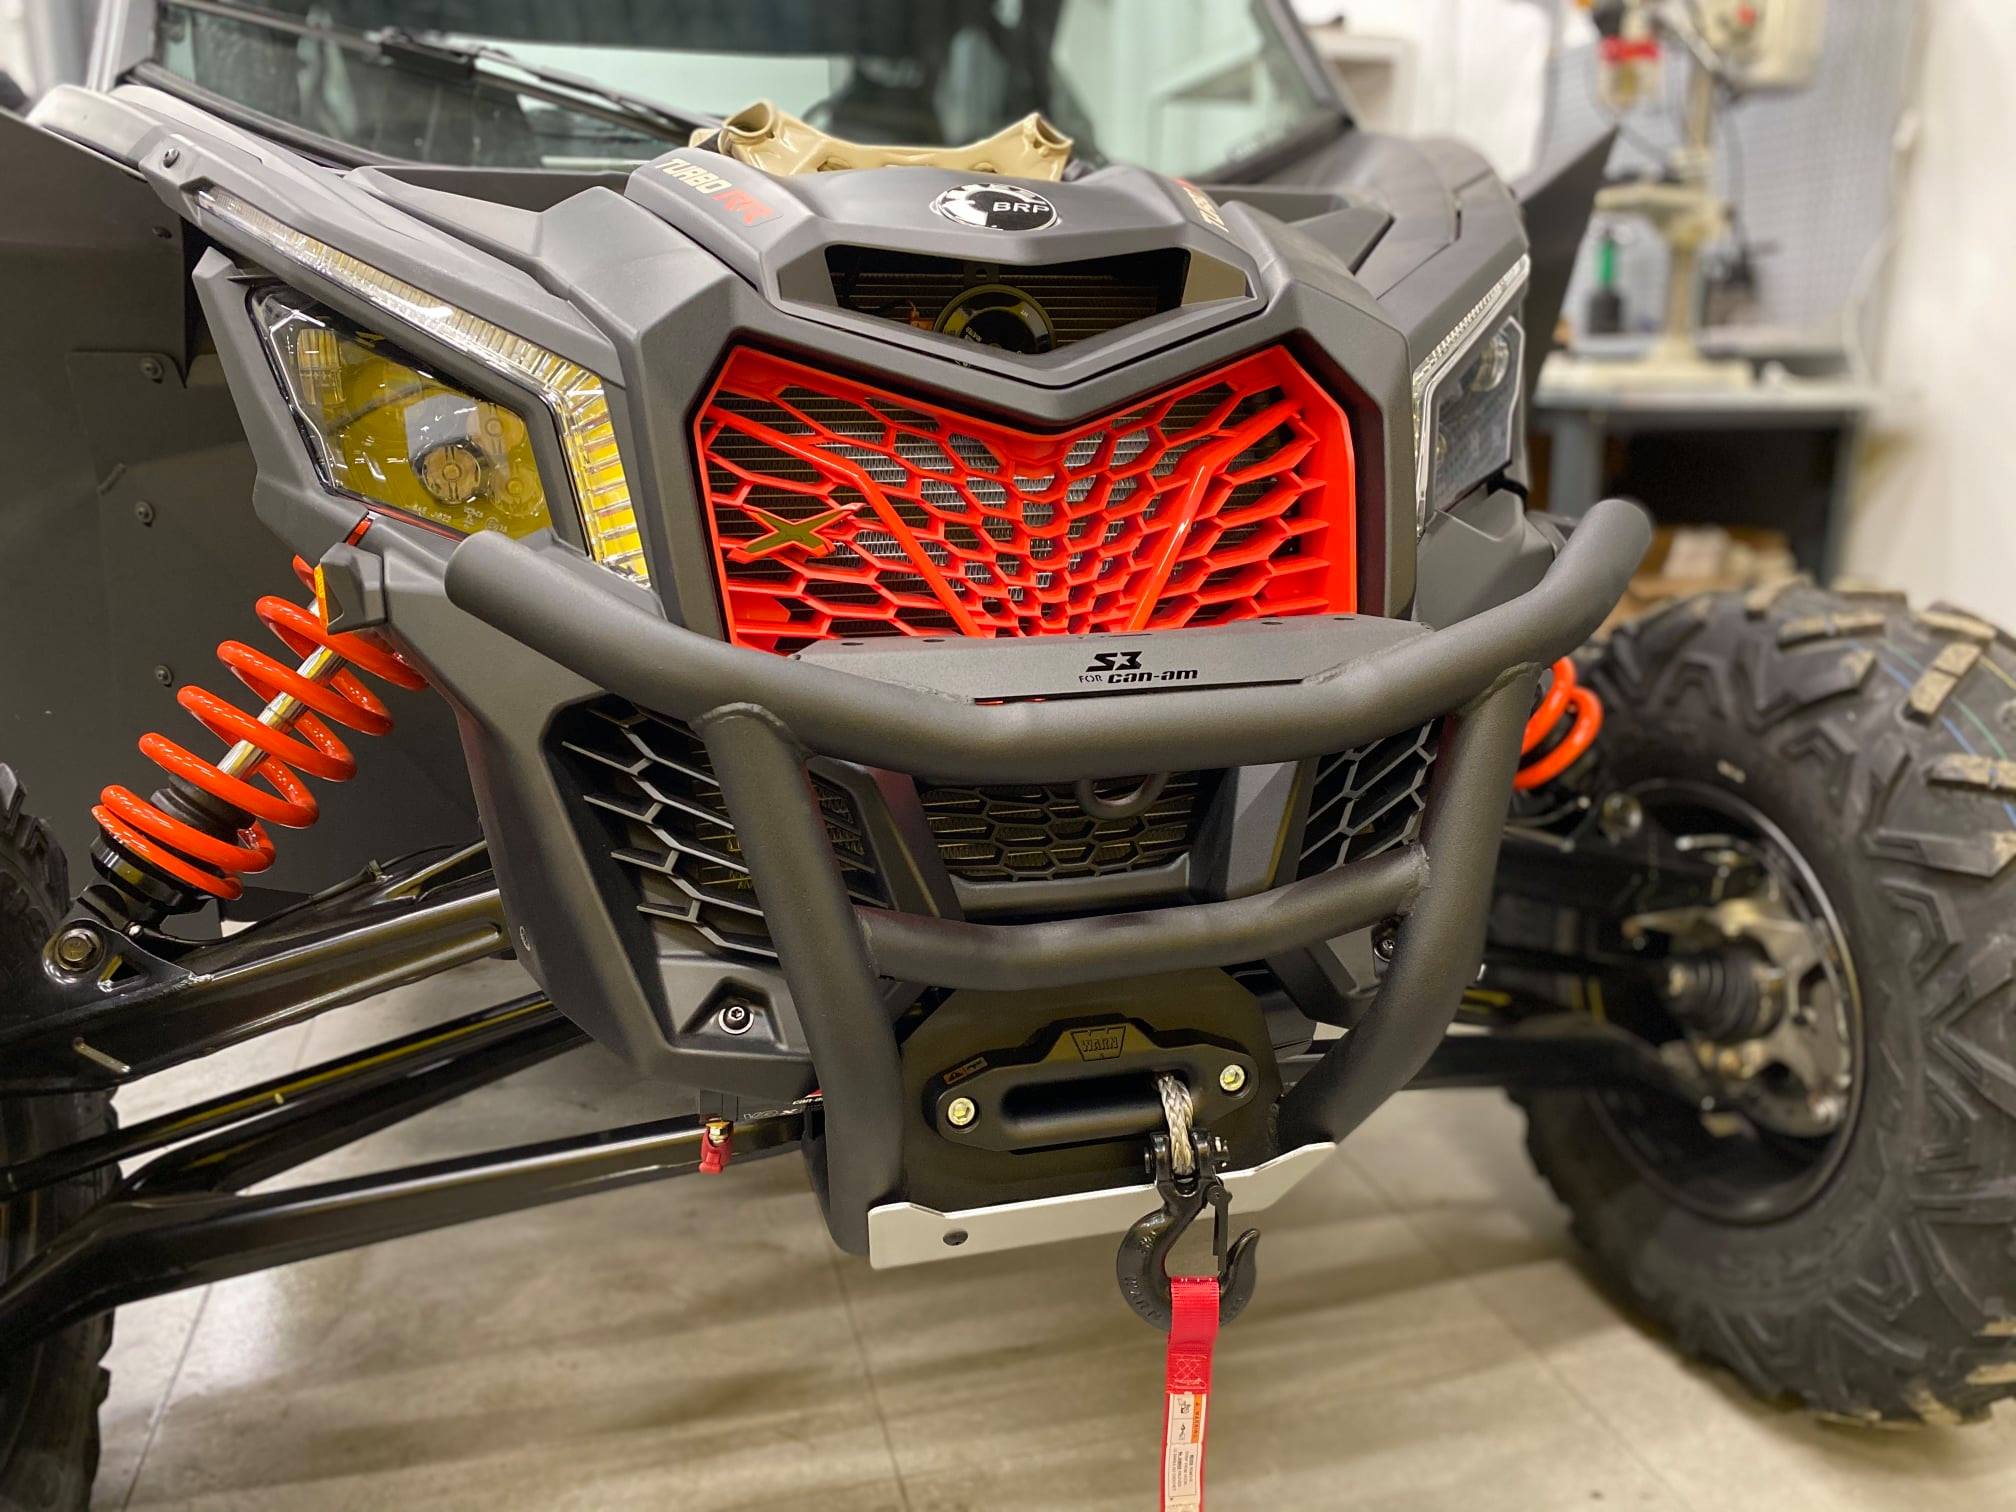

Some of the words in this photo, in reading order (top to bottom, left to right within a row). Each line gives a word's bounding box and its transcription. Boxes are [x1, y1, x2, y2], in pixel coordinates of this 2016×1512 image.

[655, 158, 732, 194] TURBO
[992, 201, 1050, 214] BRP
[1078, 674, 1103, 684] FOR
[1107, 669, 1198, 684] can-am
[1081, 1037, 1119, 1053] WARN
